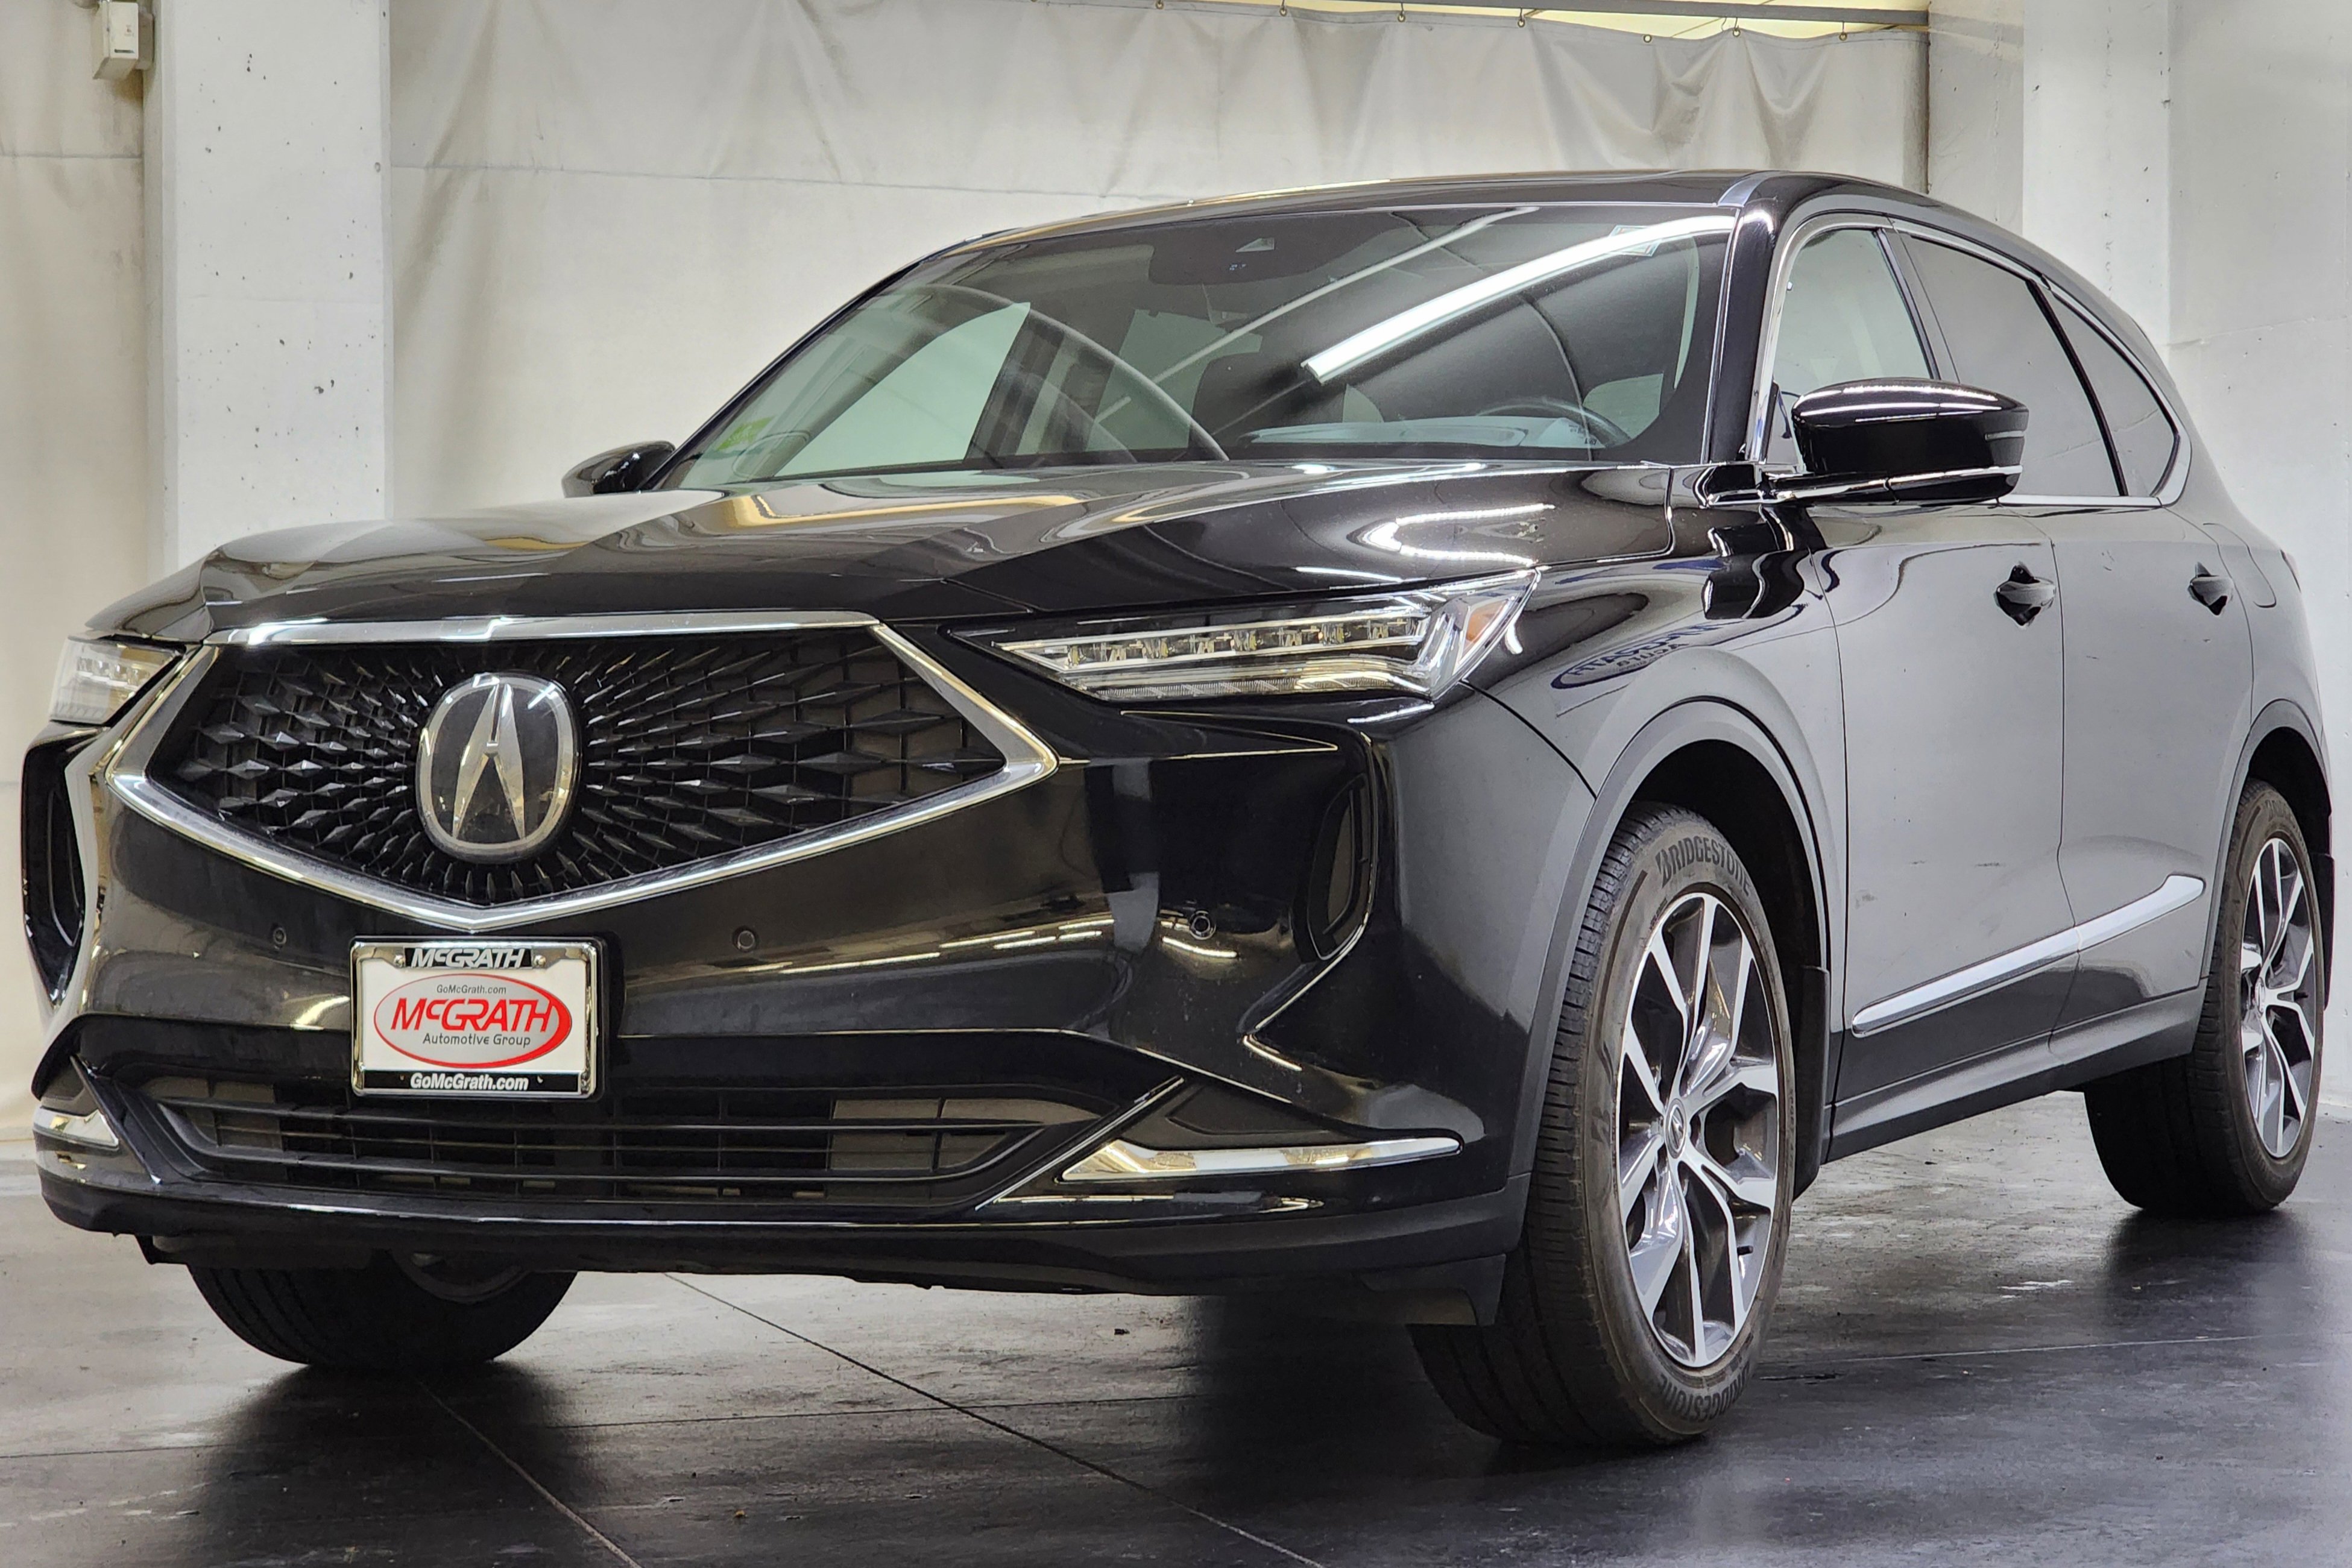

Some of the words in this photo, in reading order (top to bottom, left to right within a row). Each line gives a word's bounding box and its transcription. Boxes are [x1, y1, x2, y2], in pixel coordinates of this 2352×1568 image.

[1655, 836, 1751, 897] BRIDGESTONE
[437, 984, 506, 995] GoMcGrath.com
[423, 1033, 490, 1045] Automotive
[493, 1033, 531, 1048] Group
[410, 1072, 529, 1091] GoMcGrath.com
